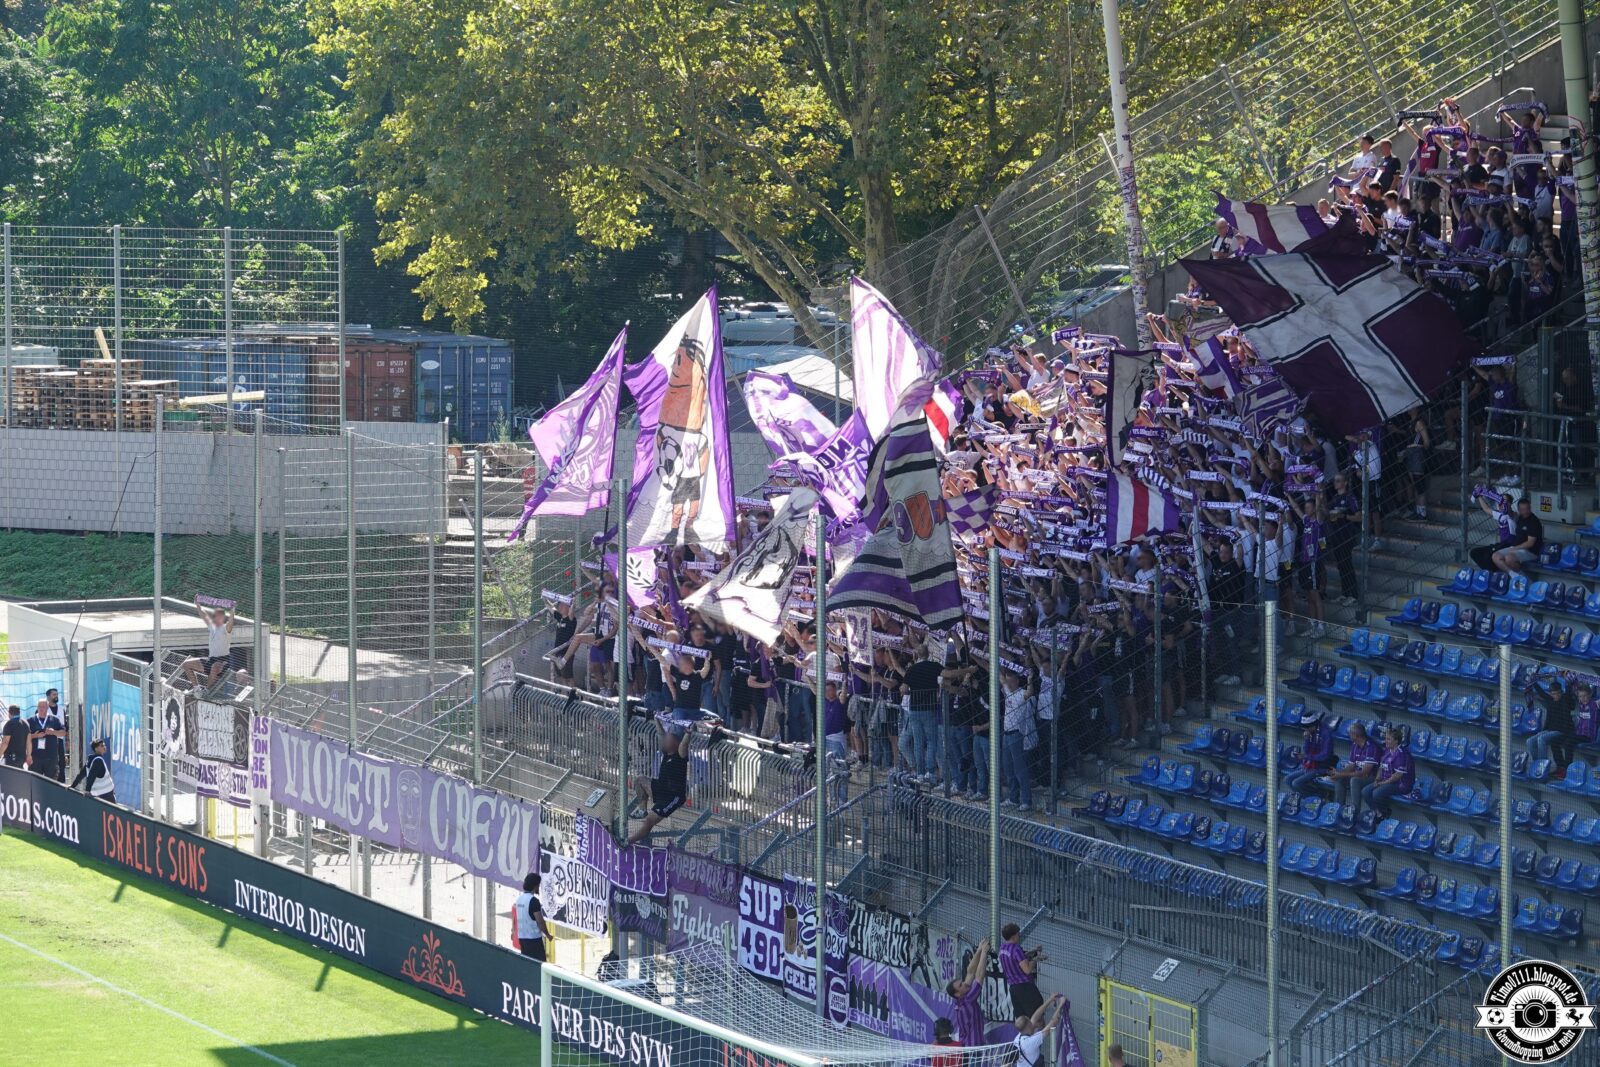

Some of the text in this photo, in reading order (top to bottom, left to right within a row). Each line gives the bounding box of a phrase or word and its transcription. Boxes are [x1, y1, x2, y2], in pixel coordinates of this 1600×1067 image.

[278, 729, 391, 833] VIOLET
[429, 776, 534, 882] CREW
[103, 811, 152, 875] ISRAEL
[170, 836, 208, 893] SONS
[235, 880, 366, 957] INTERIOR DESIGN
[739, 875, 783, 926] SUP
[741, 926, 782, 977] 490
[501, 982, 585, 1044] PARTNER
[589, 1015, 626, 1060] DES
[630, 1031, 673, 1067] SVW
